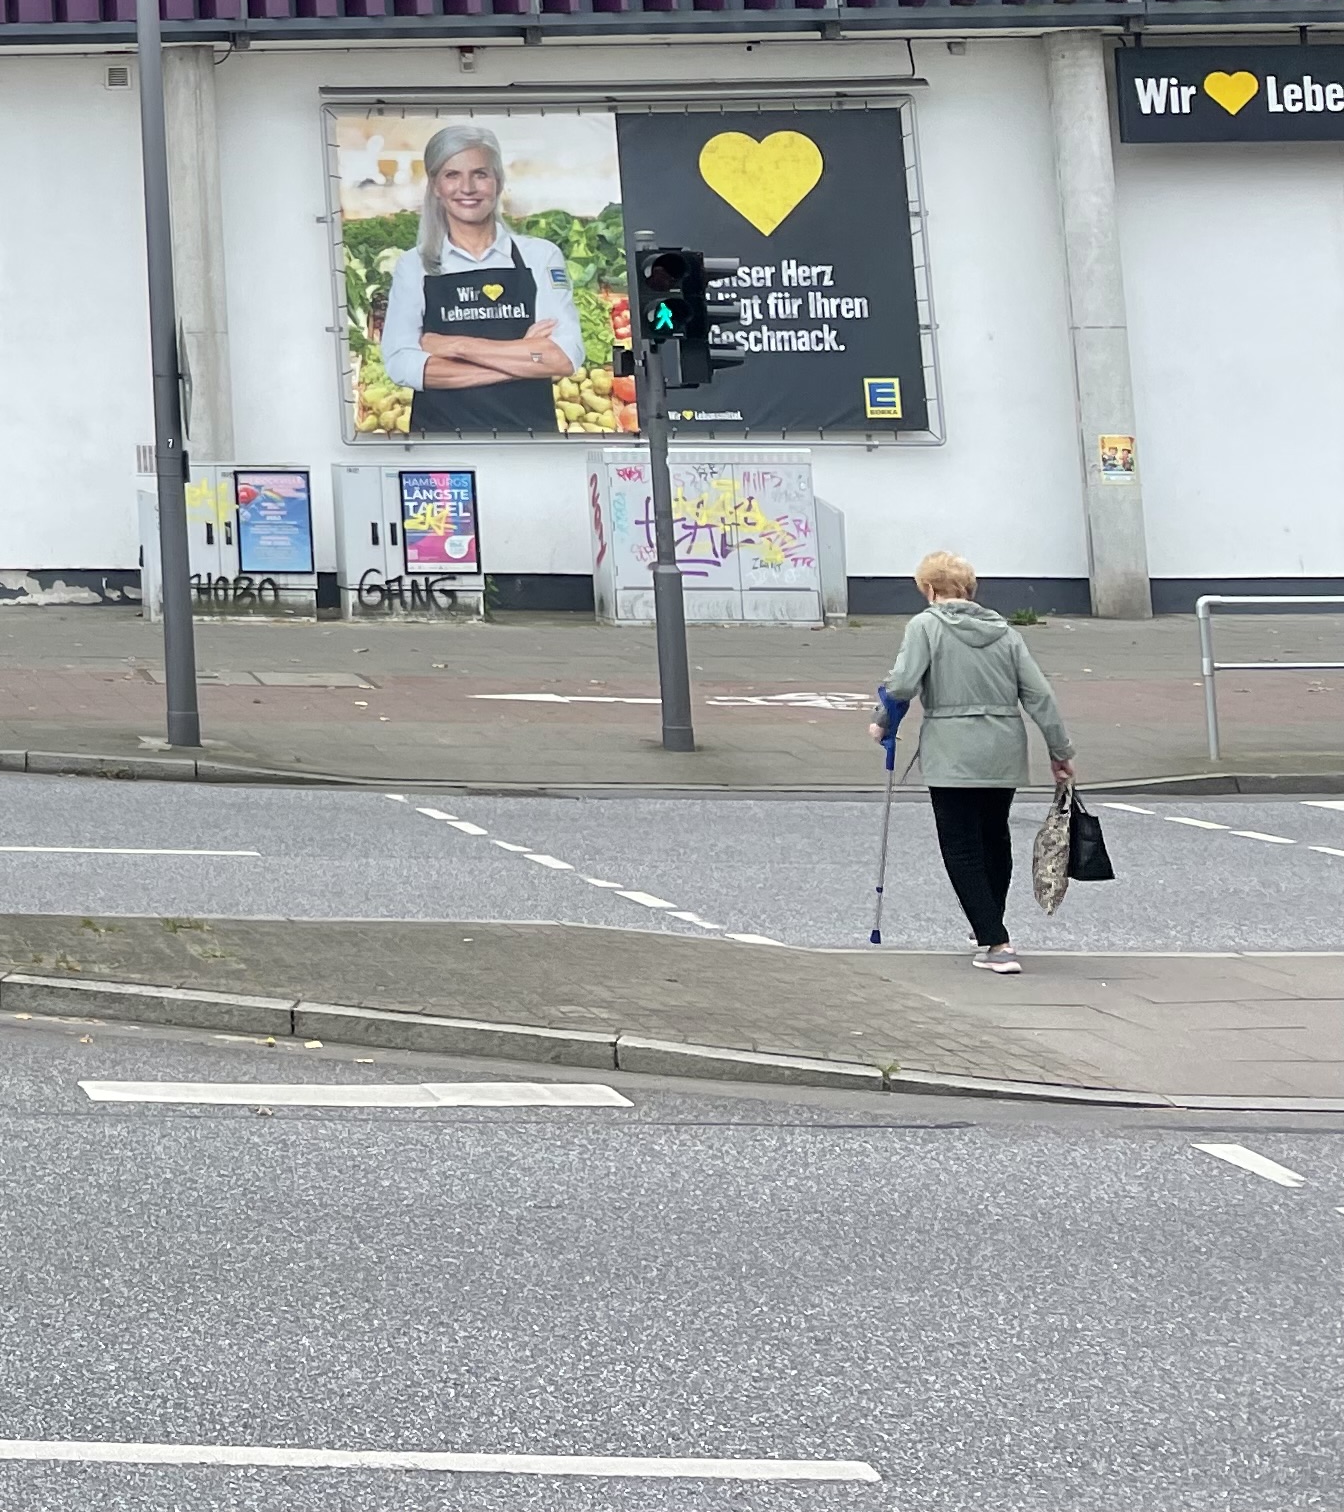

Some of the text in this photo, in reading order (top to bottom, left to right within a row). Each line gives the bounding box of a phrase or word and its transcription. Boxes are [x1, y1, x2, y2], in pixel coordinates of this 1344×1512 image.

[1134, 75, 1344, 115] Wir Lebe
[781, 259, 834, 288] Herz
[456, 286, 481, 302] Wir
[440, 302, 530, 322] Lebensmittel.
[767, 292, 803, 319] für
[808, 291, 870, 319] Ihren
[668, 410, 681, 420] Wir
[403, 477, 469, 487] HAMBURGS
[404, 487, 470, 500] LÄNGSTE
